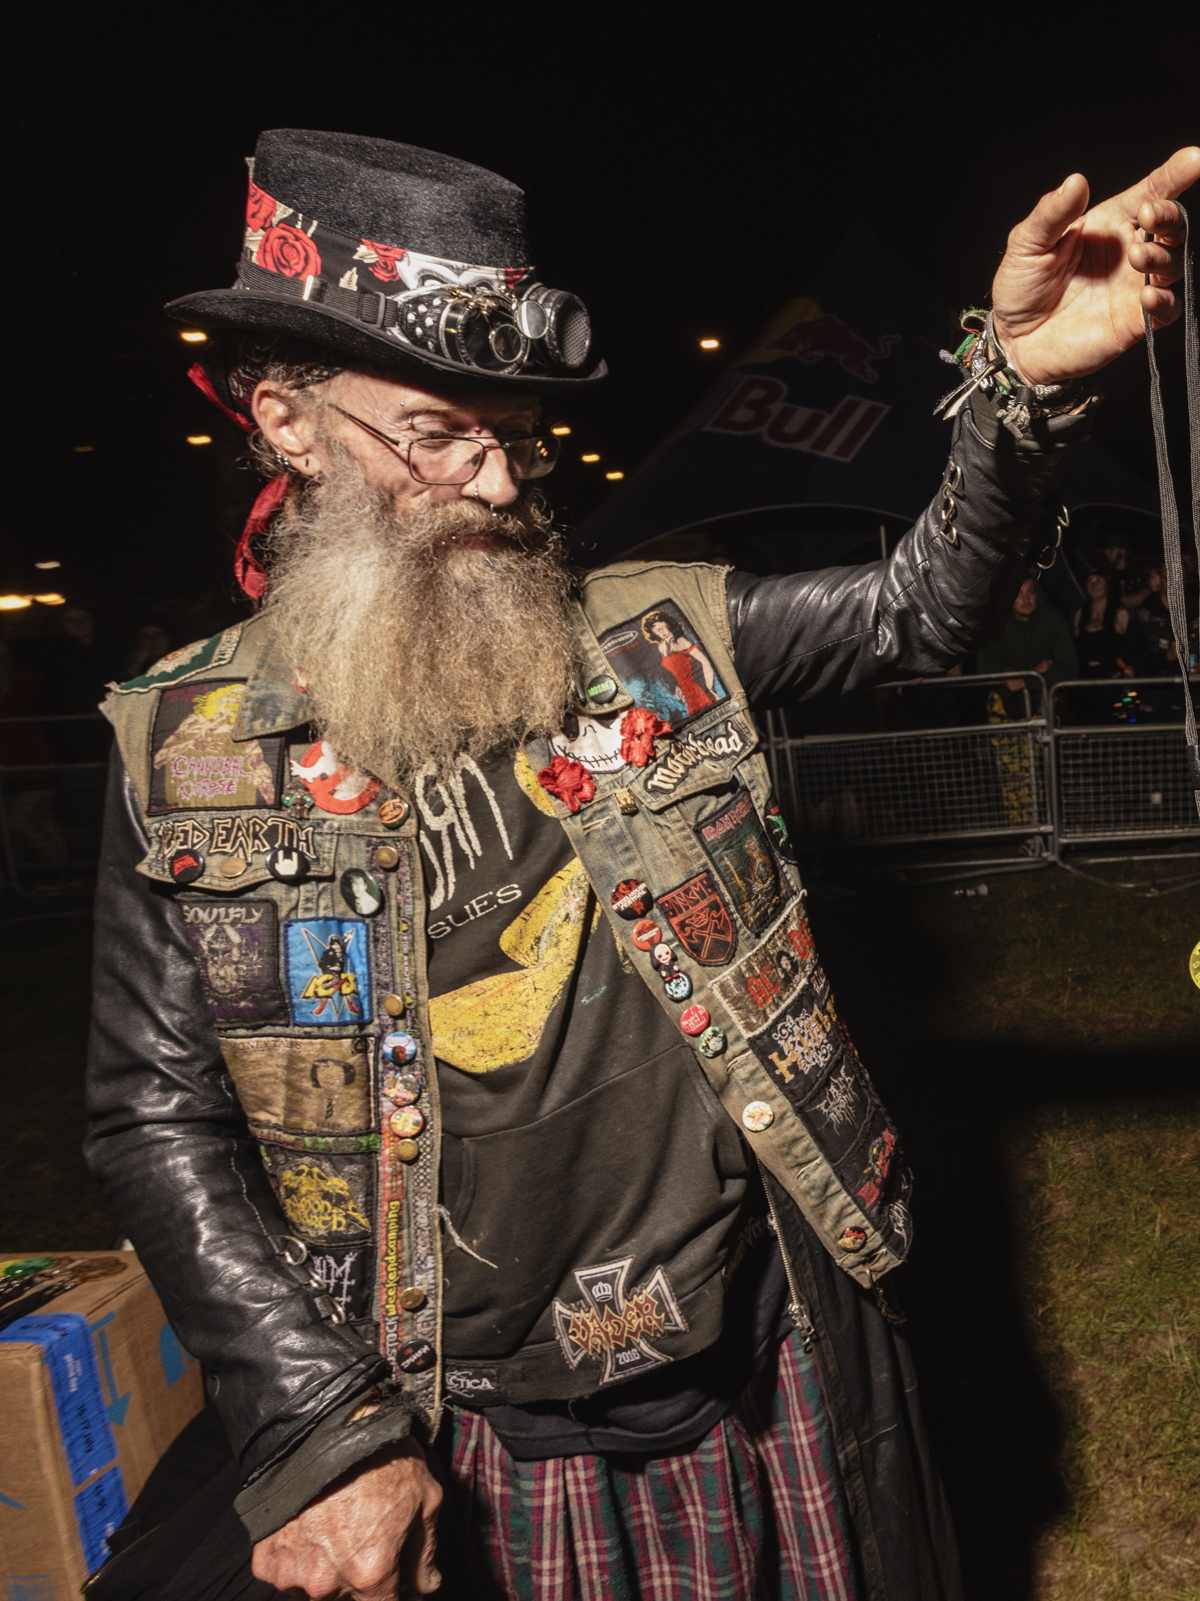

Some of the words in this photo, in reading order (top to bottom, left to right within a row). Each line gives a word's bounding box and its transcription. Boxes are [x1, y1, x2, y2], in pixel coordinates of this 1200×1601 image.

[703, 374, 891, 462] Bull
[170, 755, 252, 782] CANNIBAL
[176, 777, 239, 800] CORPSE
[209, 817, 317, 861] EARTH
[183, 904, 264, 924] SOULFLY
[568, 1289, 665, 1356] VADER
[615, 1348, 641, 1365] 2016
